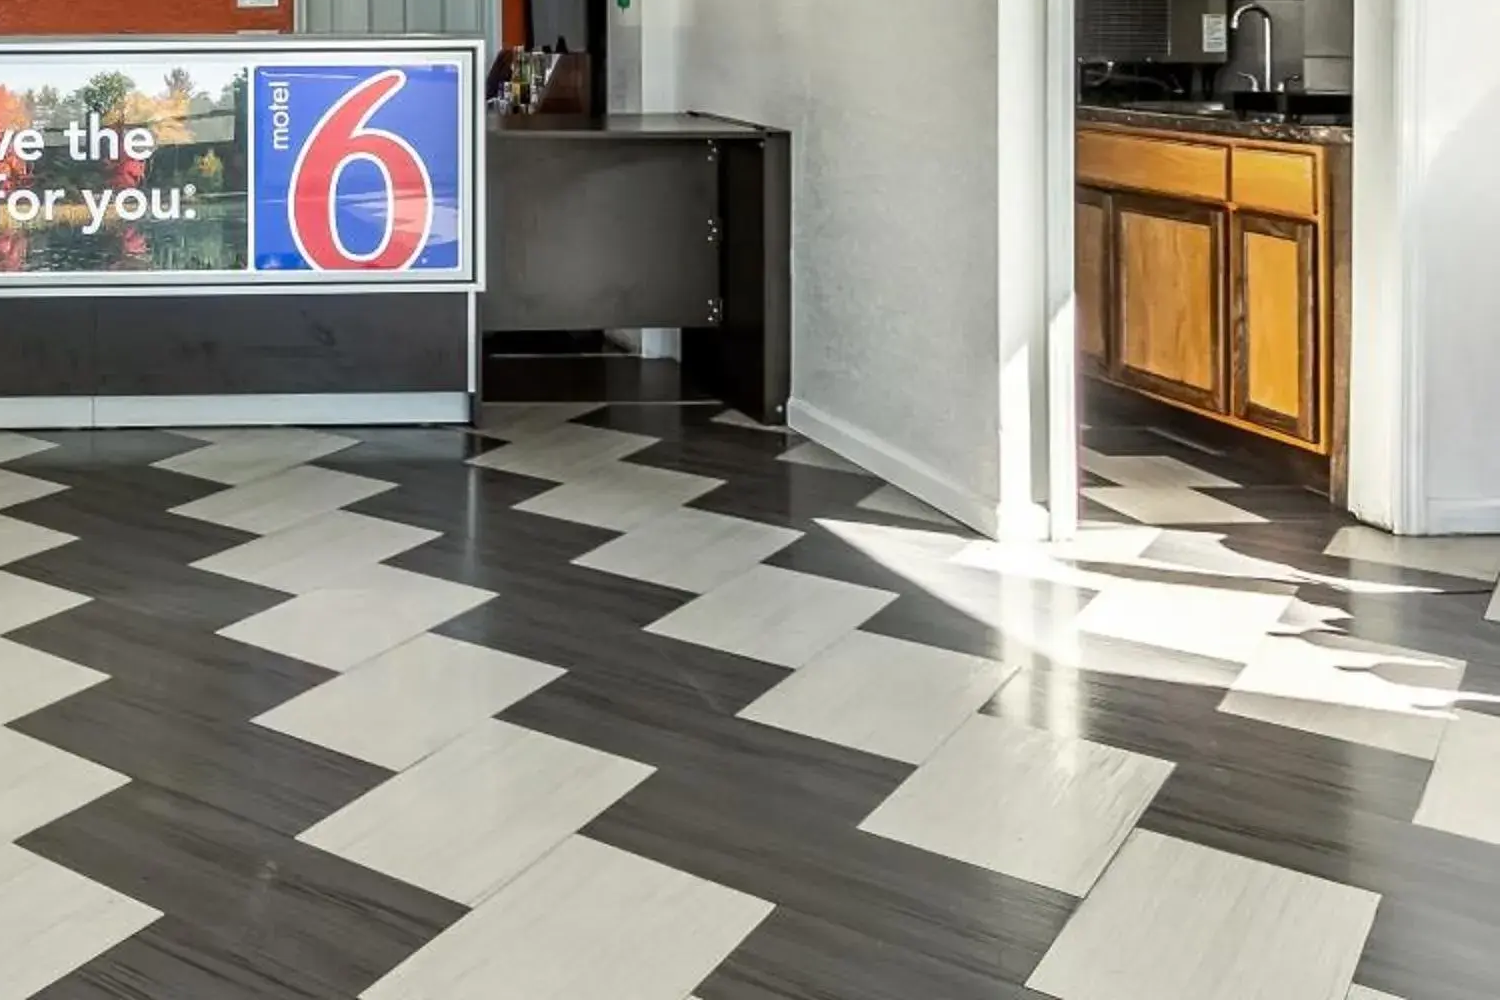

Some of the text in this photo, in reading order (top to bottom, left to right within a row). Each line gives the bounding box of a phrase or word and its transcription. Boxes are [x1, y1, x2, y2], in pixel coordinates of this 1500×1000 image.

[63, 112, 156, 161] the
[268, 68, 434, 271] motel 6
